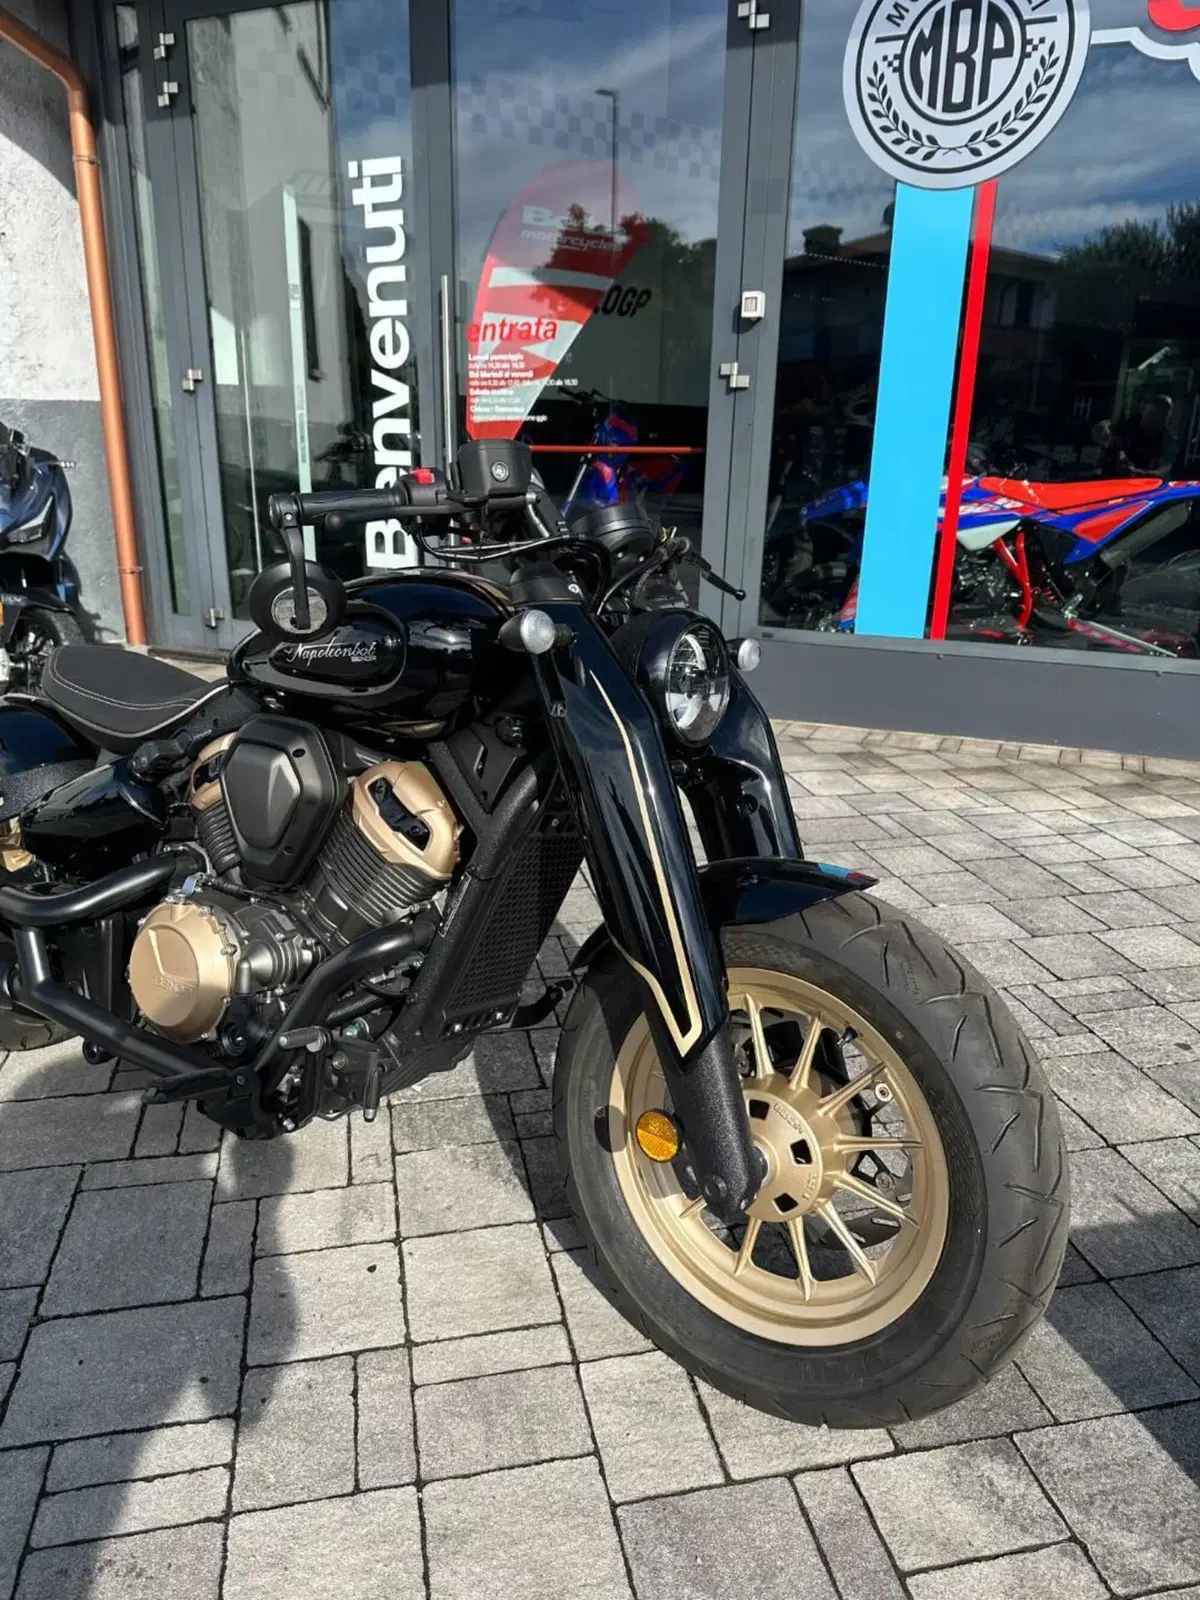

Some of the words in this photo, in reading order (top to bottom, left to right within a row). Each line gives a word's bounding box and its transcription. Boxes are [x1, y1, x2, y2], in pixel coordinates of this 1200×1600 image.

[909, 0, 1015, 114] MBP
[594, 285, 653, 318] OGP
[466, 317, 558, 342] entrata
